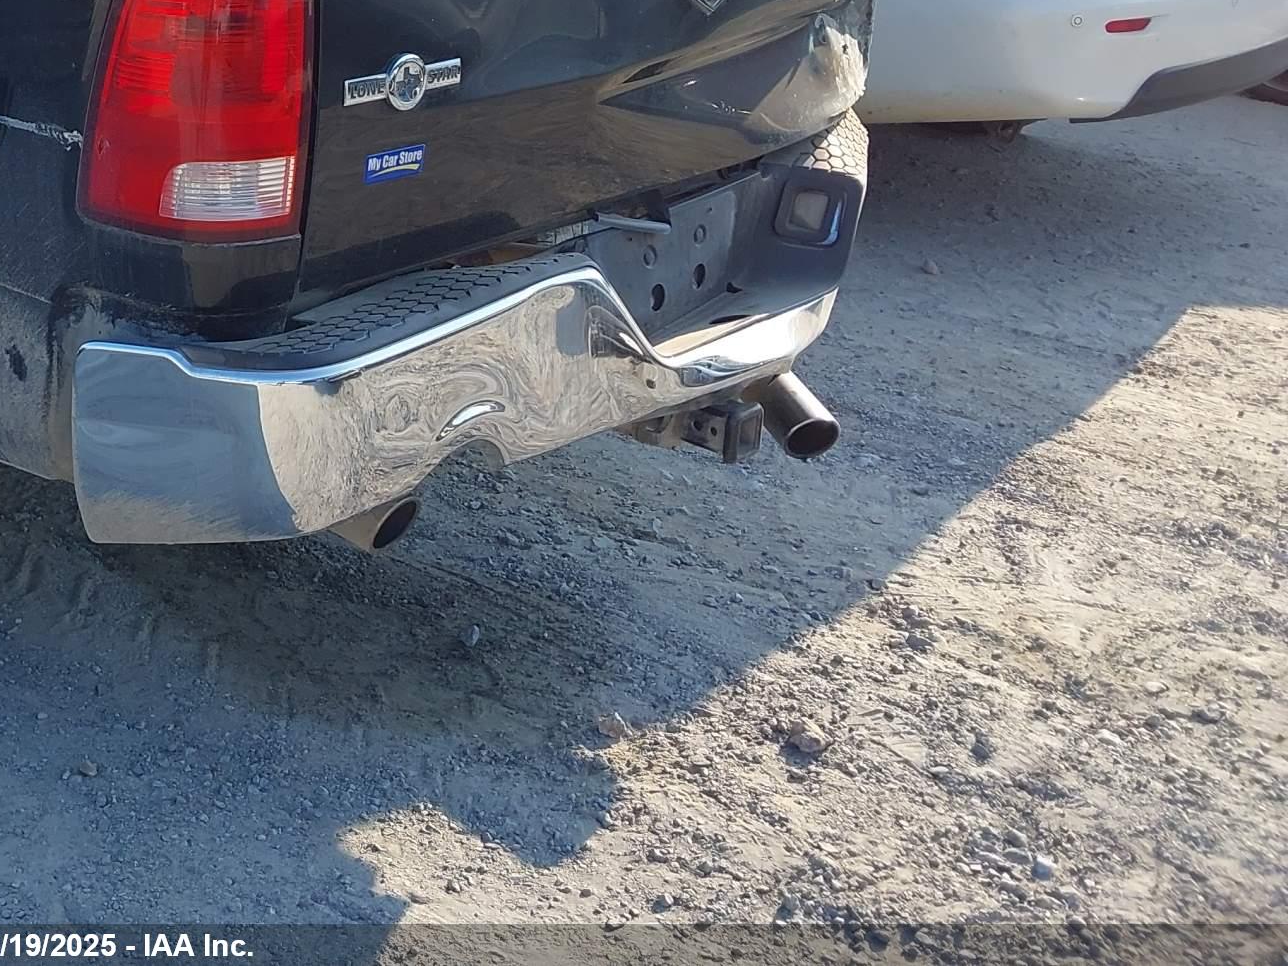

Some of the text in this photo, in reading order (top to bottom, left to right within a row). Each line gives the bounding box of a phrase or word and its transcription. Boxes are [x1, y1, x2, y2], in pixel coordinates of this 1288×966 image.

[349, 65, 461, 99] LONE STAR
[368, 150, 423, 172] My Car Store
